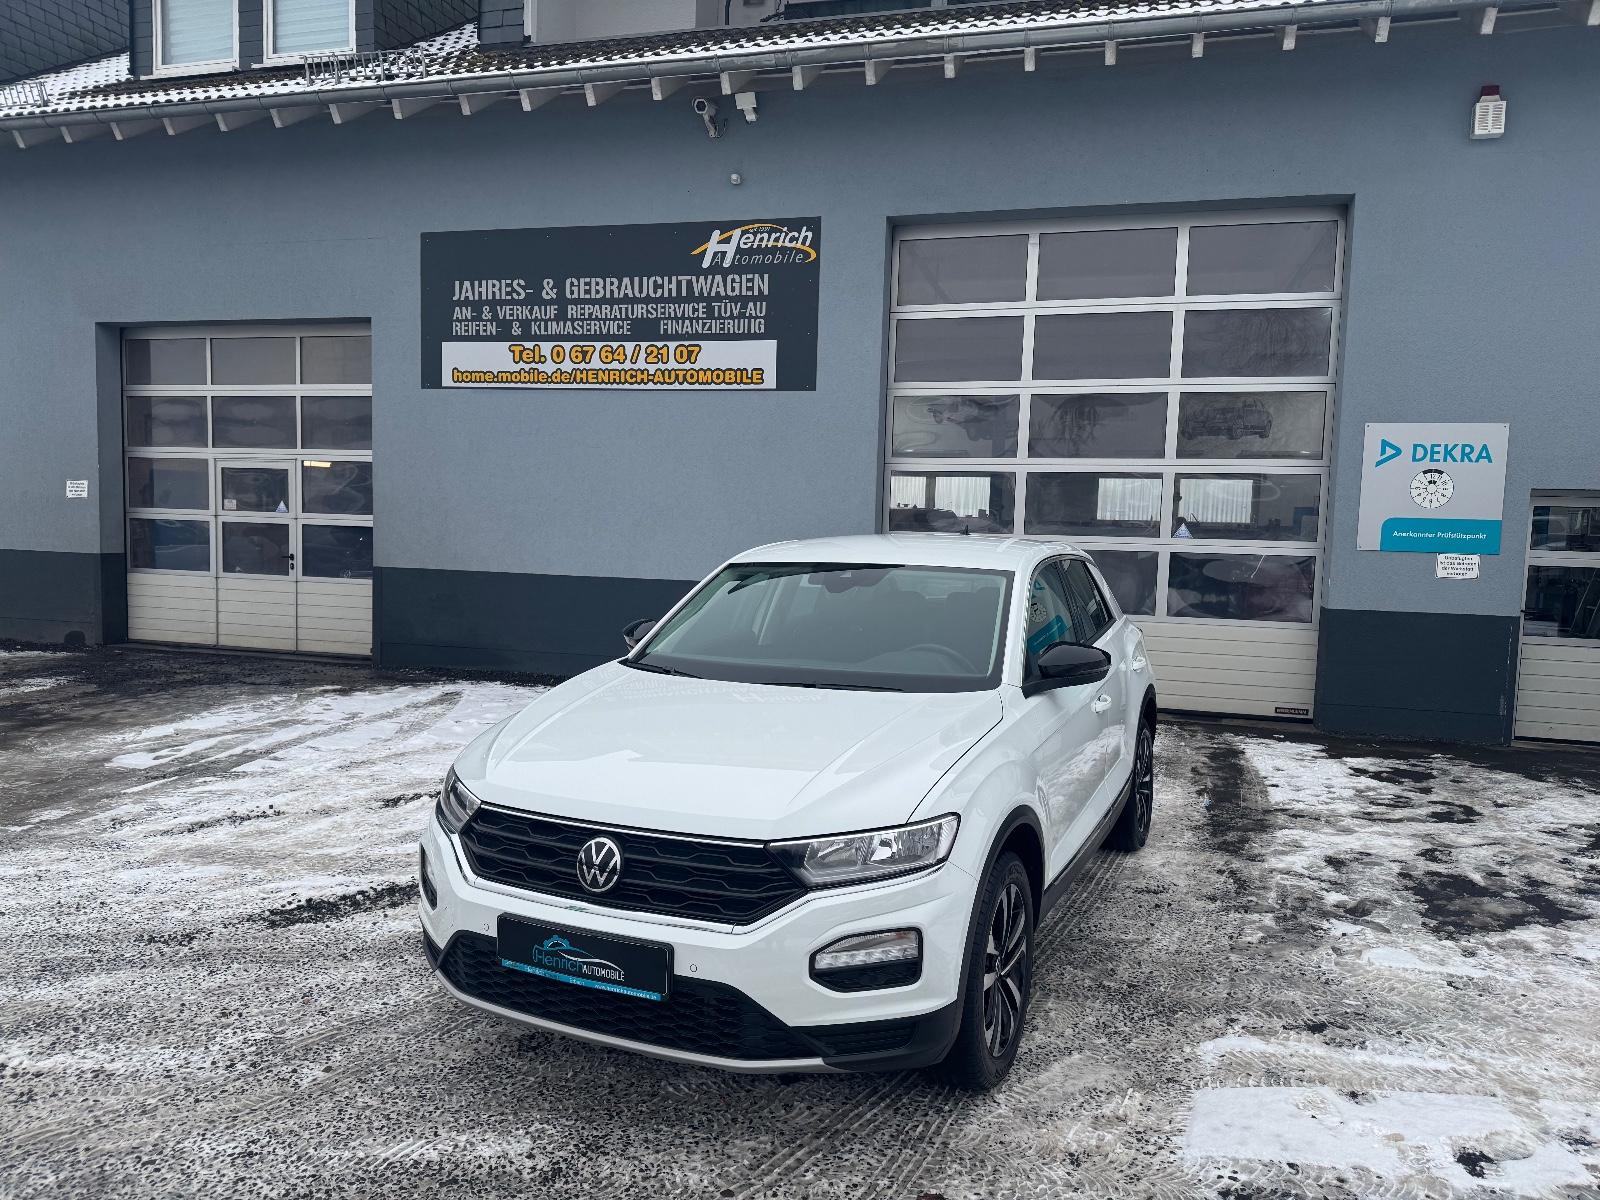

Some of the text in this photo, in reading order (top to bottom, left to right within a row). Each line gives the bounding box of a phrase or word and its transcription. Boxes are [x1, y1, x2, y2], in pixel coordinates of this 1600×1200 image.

[701, 226, 813, 269] Henrich
[452, 273, 769, 301] JAHRES- & GEBRAUCHTWAGEN
[452, 300, 767, 320] AN- & VERKAUF REPARATURSERVICE TÜV-AU
[452, 318, 765, 336] REIFEN- & KLIMASERVICE FINANZIERUNG
[509, 344, 702, 365] Tel. 0 67 64 / 21 07
[452, 367, 765, 385] home.mobile.de/HENRICH-AUTOMOBILE
[1411, 443, 1493, 464] DEKRA
[1392, 529, 1487, 540] Anerkannter Prüfstützpunkt
